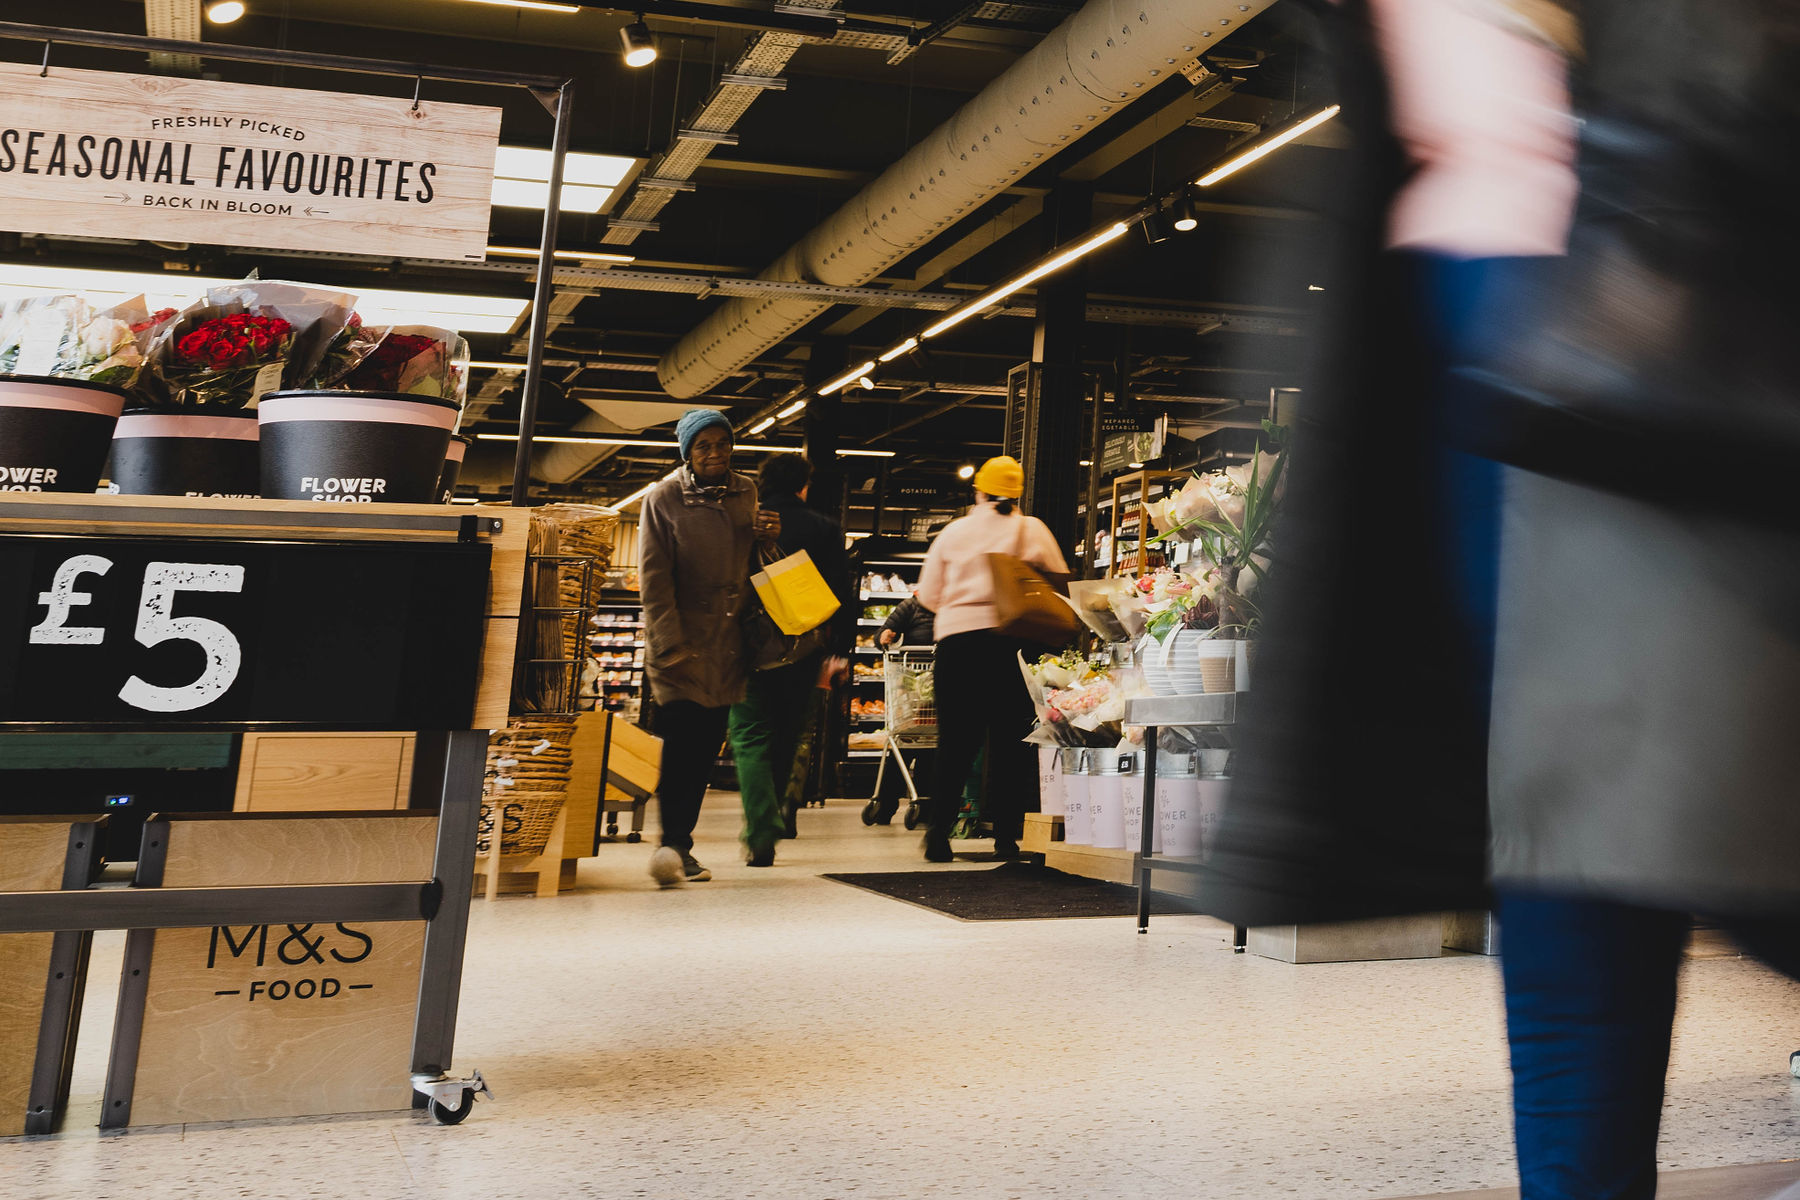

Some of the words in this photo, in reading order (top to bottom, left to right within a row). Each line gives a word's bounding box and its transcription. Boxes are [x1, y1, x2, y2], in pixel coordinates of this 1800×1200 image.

[151, 115, 234, 131] FRESHLY
[239, 117, 306, 142] PICKED
[0, 128, 197, 187] SEASONAL
[215, 145, 437, 205] FAVOURITES
[142, 194, 194, 210] BACK
[200, 199, 219, 211] IN
[226, 200, 293, 217] BLOOM
[299, 477, 387, 494] FLOWER
[28, 553, 246, 713] £5
[206, 922, 373, 969] M&S
[248, 977, 341, 1002] FOOD
